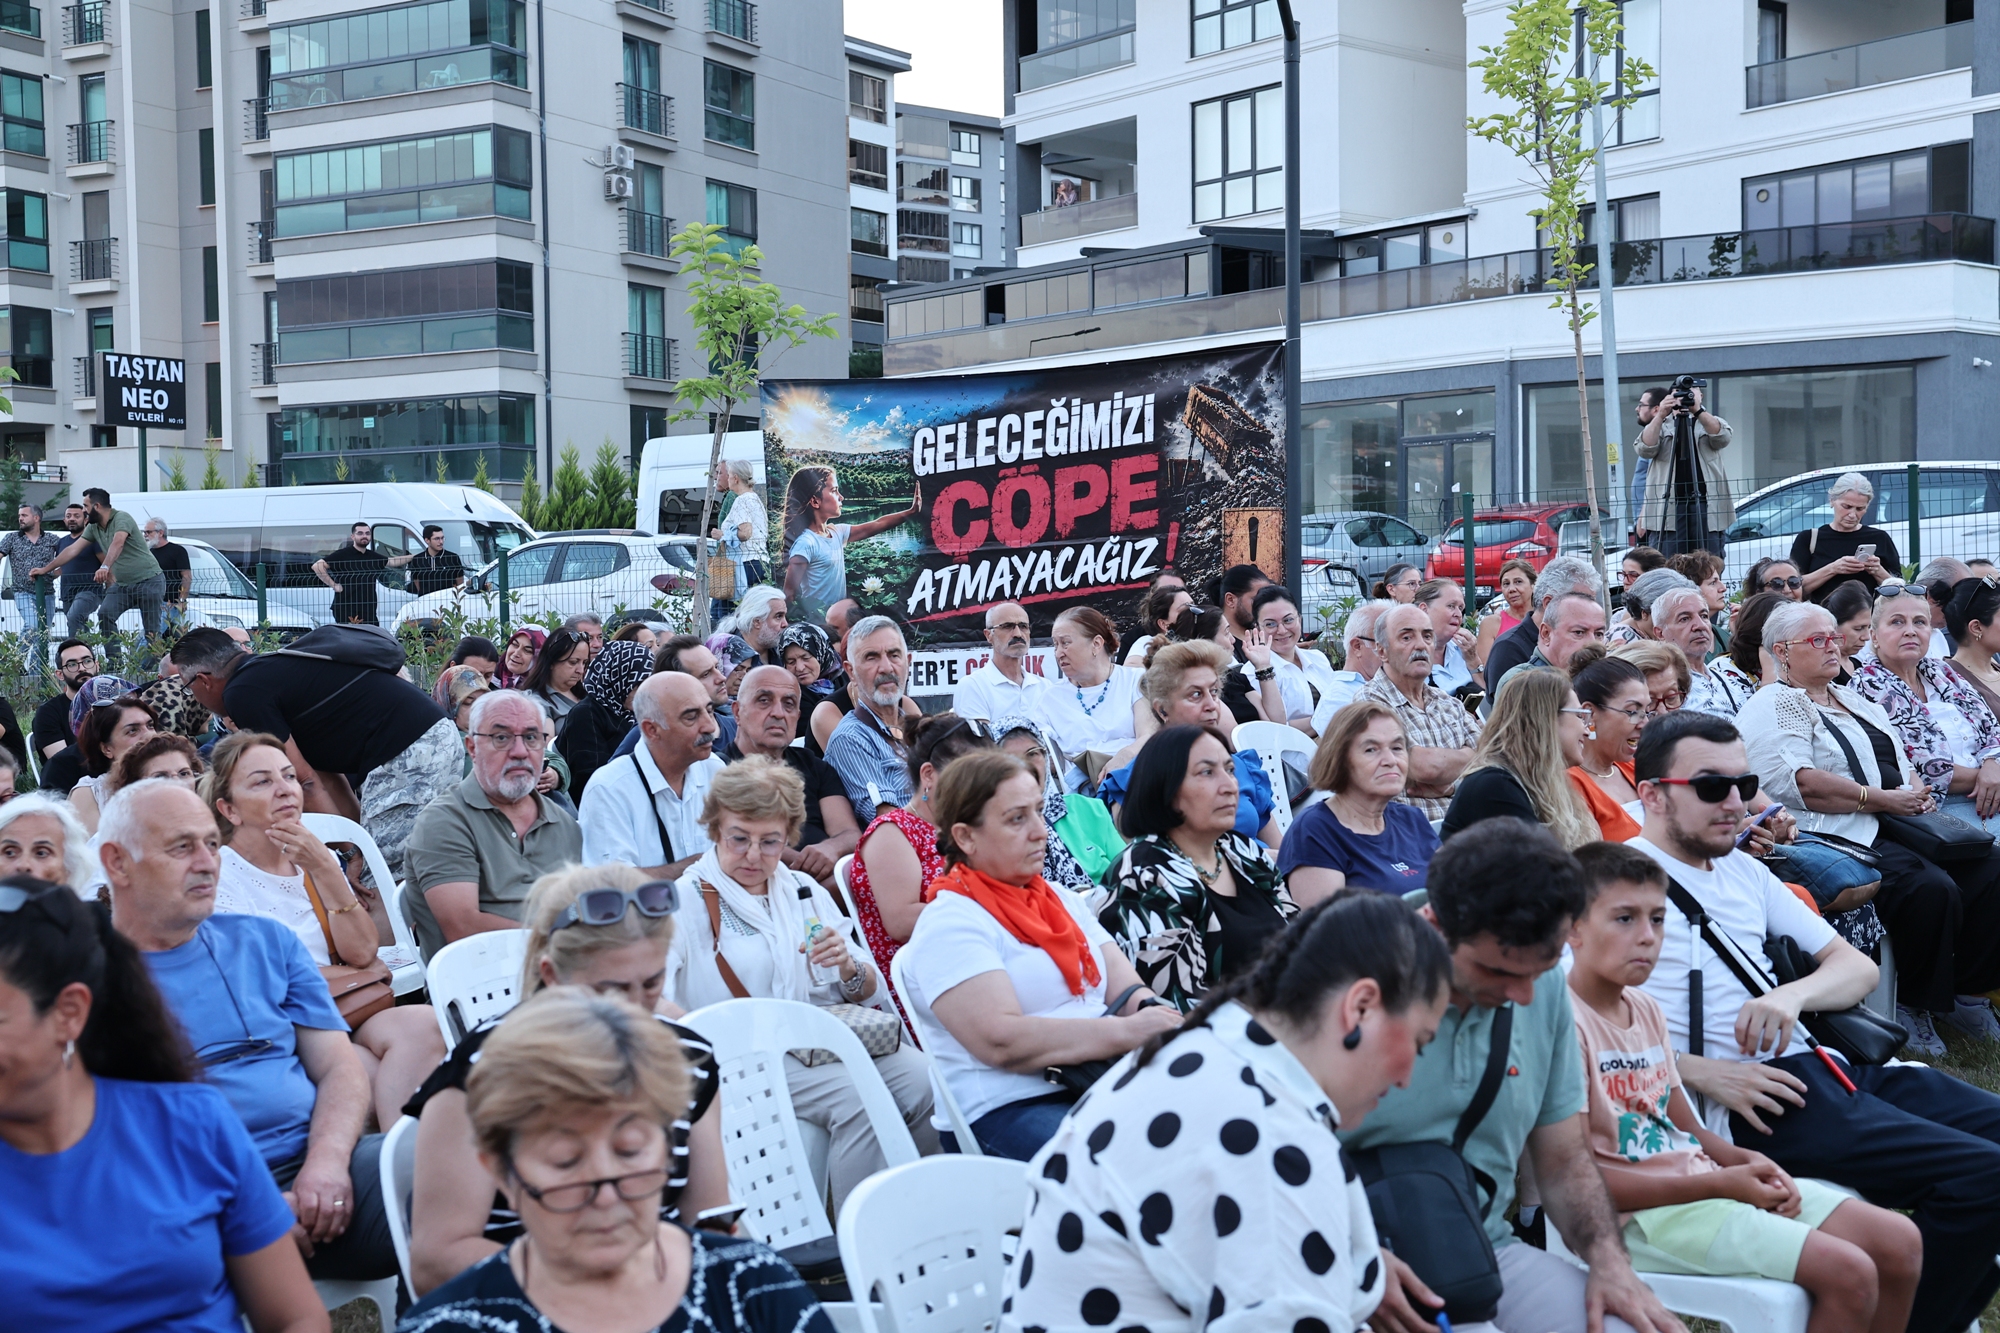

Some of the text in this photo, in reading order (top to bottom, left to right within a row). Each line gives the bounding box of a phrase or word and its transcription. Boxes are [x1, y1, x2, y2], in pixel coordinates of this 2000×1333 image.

[105, 354, 184, 386] TAŞTAN
[121, 386, 169, 411] NEO
[127, 411, 165, 423] EVLERİ
[930, 451, 1160, 564] ÇÖPE
